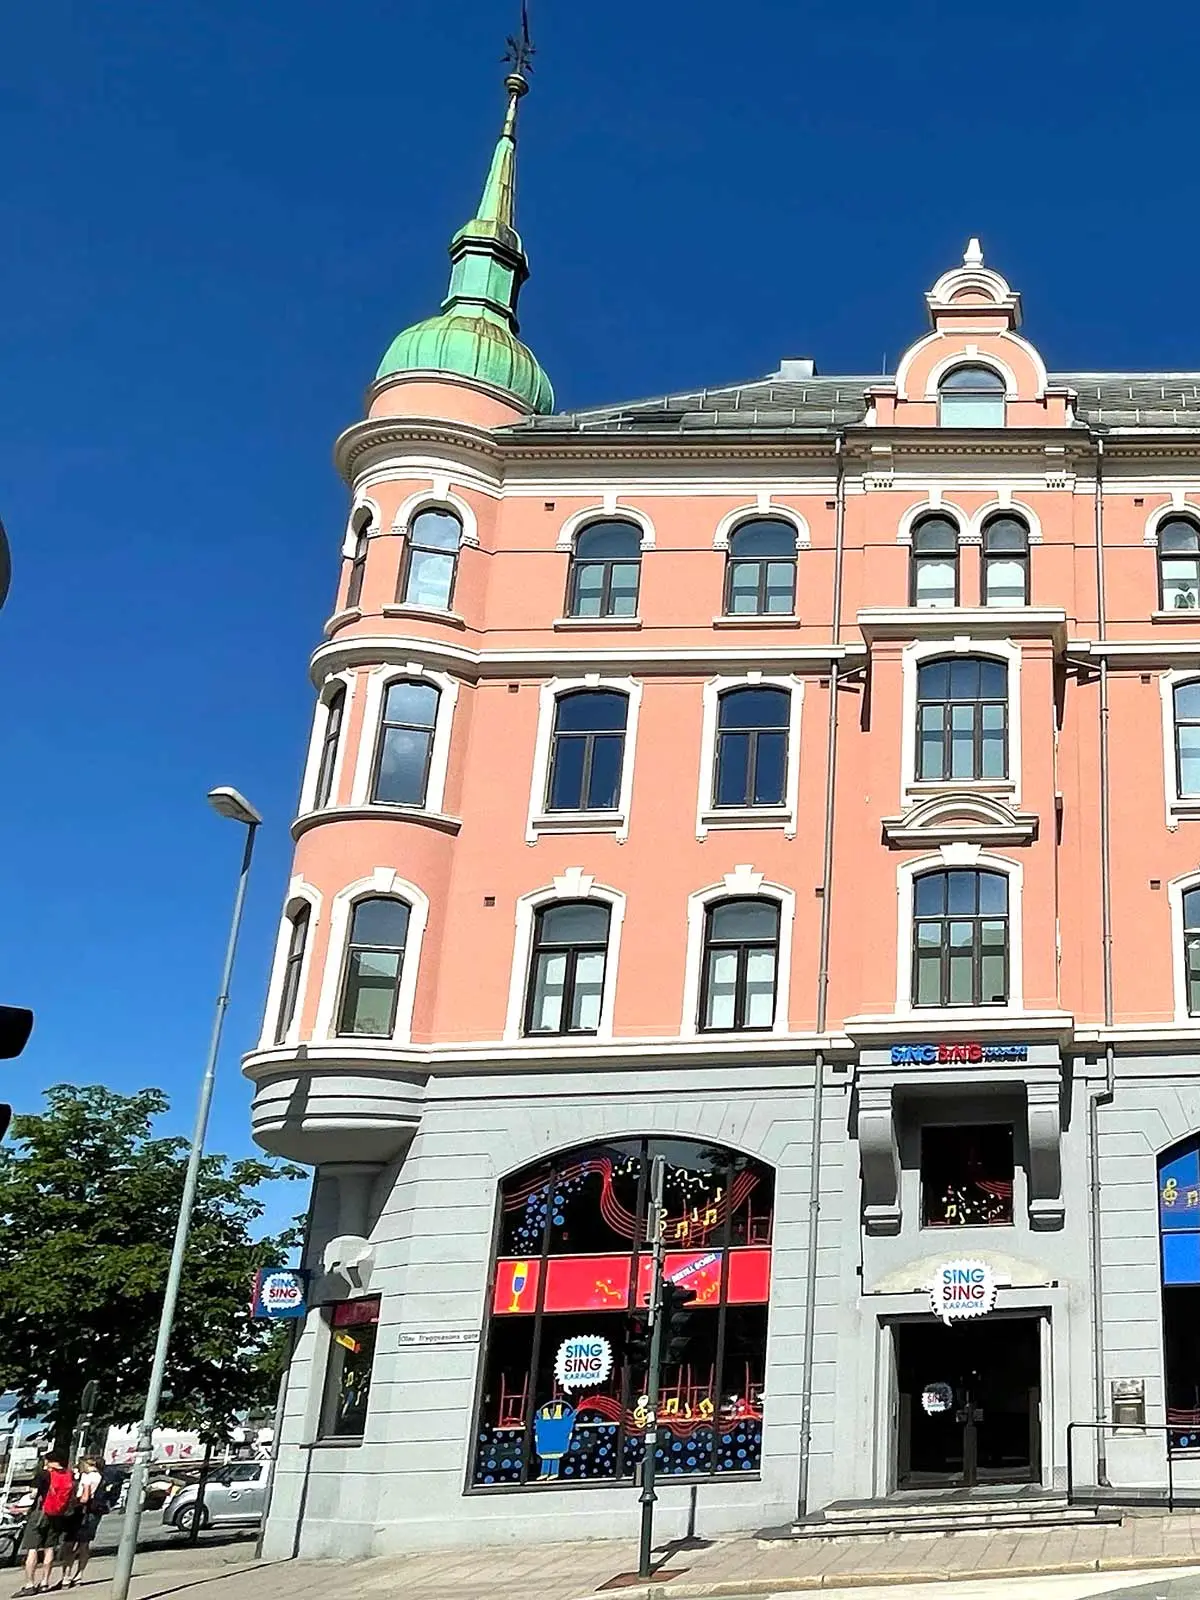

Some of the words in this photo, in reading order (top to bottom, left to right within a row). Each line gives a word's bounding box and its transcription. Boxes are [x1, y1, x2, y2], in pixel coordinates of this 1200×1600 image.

[890, 1044, 936, 1063] SING
[938, 1043, 981, 1063] SING
[943, 1268, 984, 1284] SING
[271, 1279, 298, 1288] SING
[269, 1289, 298, 1298] SING
[943, 1285, 985, 1301] SING
[943, 1301, 984, 1309] KARAOKE
[565, 1344, 602, 1358] SING
[565, 1358, 602, 1372] SING
[564, 1371, 600, 1380] KARAOKE
